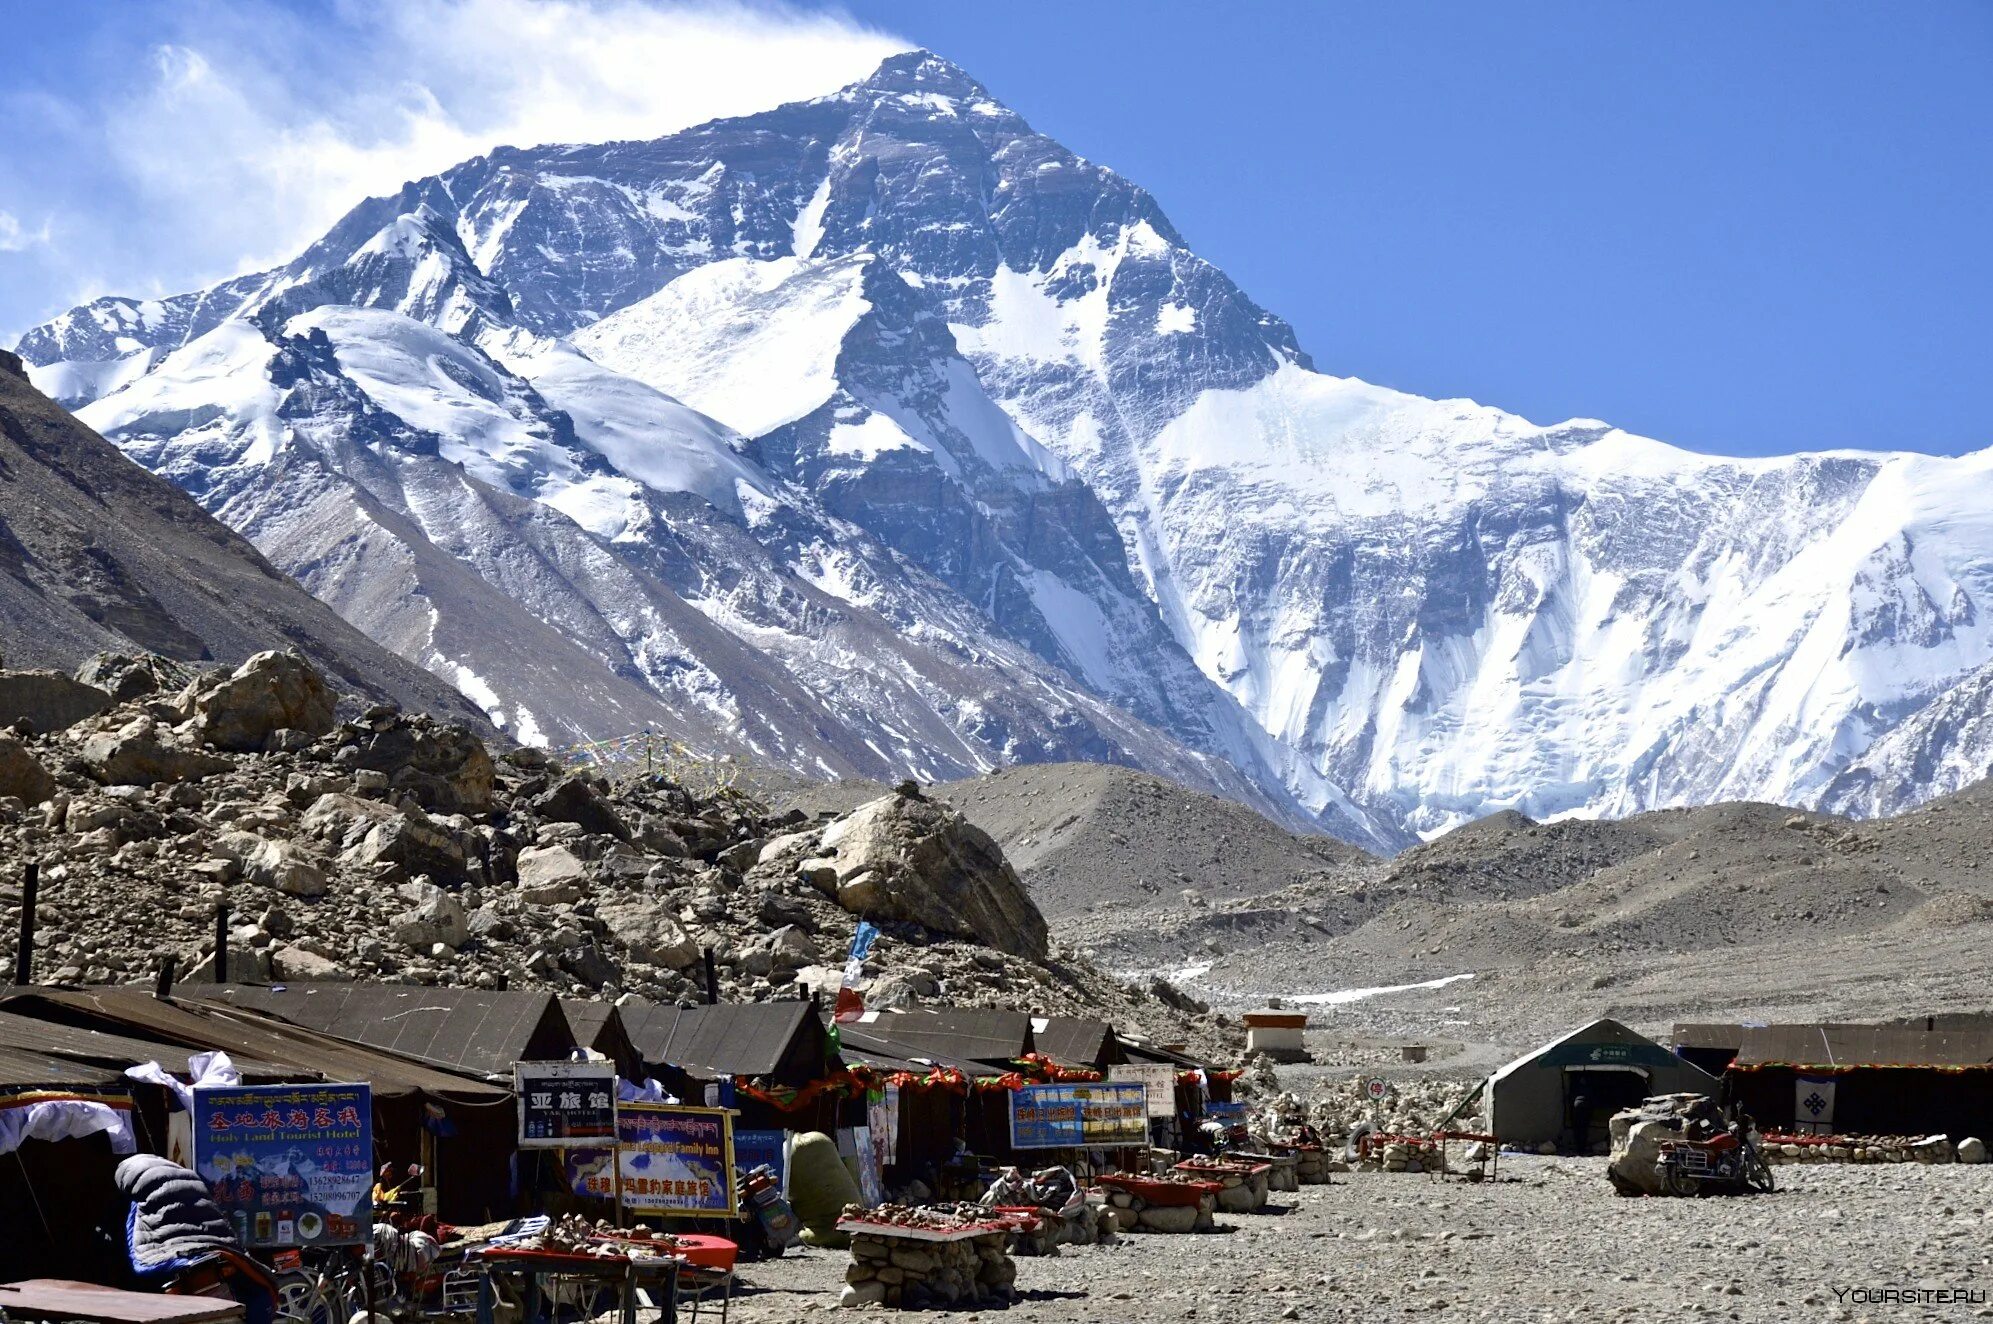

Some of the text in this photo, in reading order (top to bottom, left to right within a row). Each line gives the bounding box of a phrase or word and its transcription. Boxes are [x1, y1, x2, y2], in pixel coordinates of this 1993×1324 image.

[1370, 1082, 1384, 1095] 停
[530, 1091, 610, 1109] 亚旅馆
[208, 1106, 362, 1130] 圣地旅游客栈
[210, 1129, 360, 1143] Holy Land Tourist Hotel
[675, 1141, 703, 1157] Family
[705, 1142, 720, 1155] Inn
[586, 1177, 710, 1197] 珠穆玛雪豹家庭旅馆
